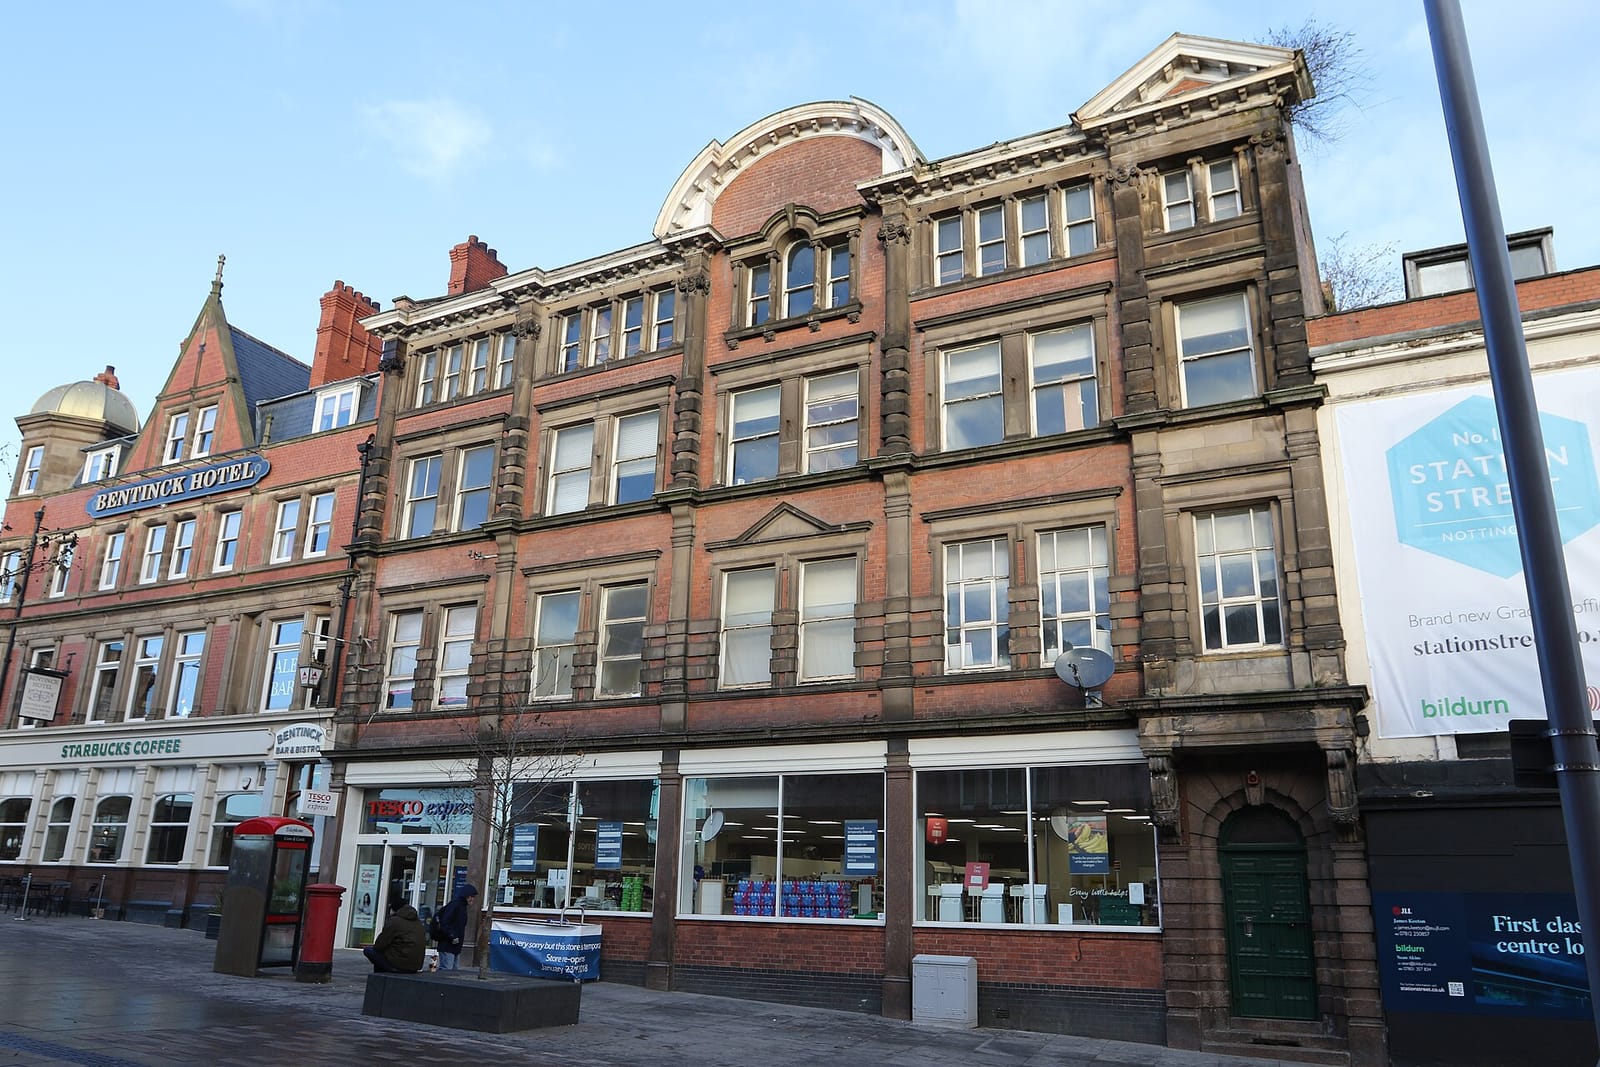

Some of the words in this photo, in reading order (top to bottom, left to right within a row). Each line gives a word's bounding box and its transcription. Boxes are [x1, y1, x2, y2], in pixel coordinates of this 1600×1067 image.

[1409, 445, 1569, 484] STATIN
[95, 475, 186, 511] BENTINCK
[189, 461, 255, 491] HOTEL
[1408, 610, 1453, 628] Brand
[1458, 610, 1491, 623] new
[1573, 598, 1600, 614] offi
[276, 658, 298, 673] ALE
[271, 680, 295, 697] BAR
[1421, 696, 1509, 719] bildurn
[276, 727, 323, 745] BENTINCK
[61, 741, 132, 758] STARBUCKS
[133, 739, 182, 755] COFFEE
[275, 746, 289, 754] BAR
[295, 745, 321, 754] BISTRO
[308, 792, 331, 802] TESCO
[307, 803, 329, 812] express
[367, 799, 424, 816] TESCO
[426, 800, 475, 820] expres
[1069, 887, 1089, 900] Every
[1107, 888, 1128, 898] helps
[1492, 915, 1541, 933] First
[1546, 916, 1582, 933] clas
[529, 942, 544, 951] sorry
[544, 942, 555, 950] but
[555, 942, 565, 950] this
[566, 943, 580, 951] store
[584, 942, 602, 952] tempora
[1395, 944, 1425, 952] bildurn
[1496, 939, 1560, 954] centre
[545, 953, 562, 963] Store
[541, 963, 564, 974] January
